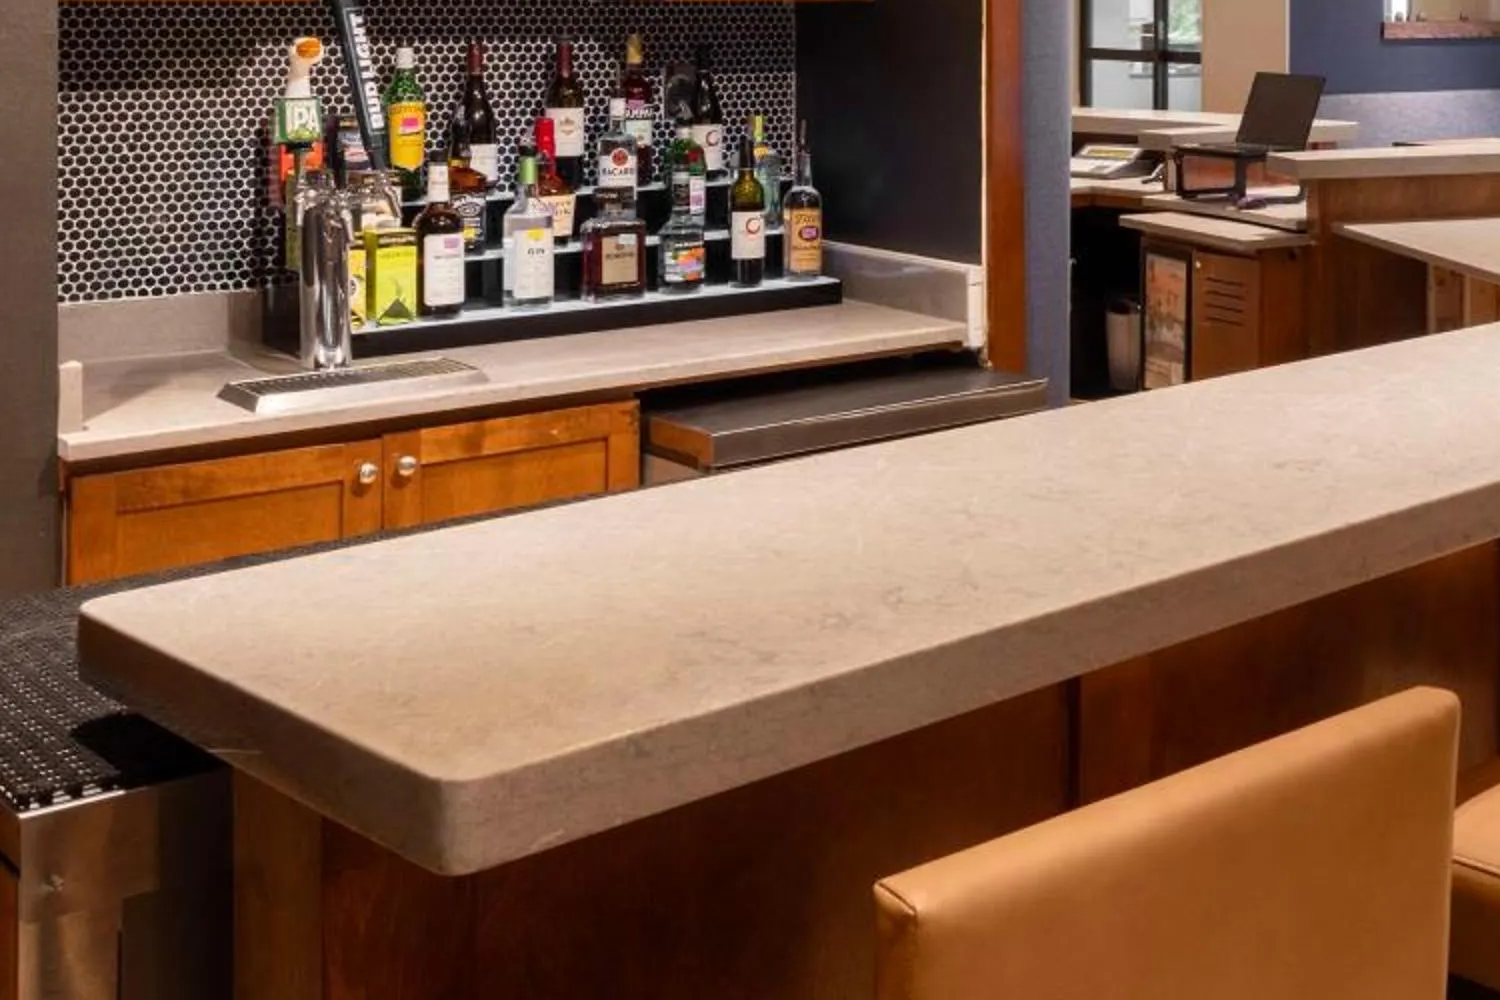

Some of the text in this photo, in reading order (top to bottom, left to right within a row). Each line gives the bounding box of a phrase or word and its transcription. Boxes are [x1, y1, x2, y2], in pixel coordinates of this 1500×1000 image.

[349, 13, 385, 129] BUD LIGHT
[285, 101, 321, 134] IPA
[602, 167, 636, 176] BACARD
